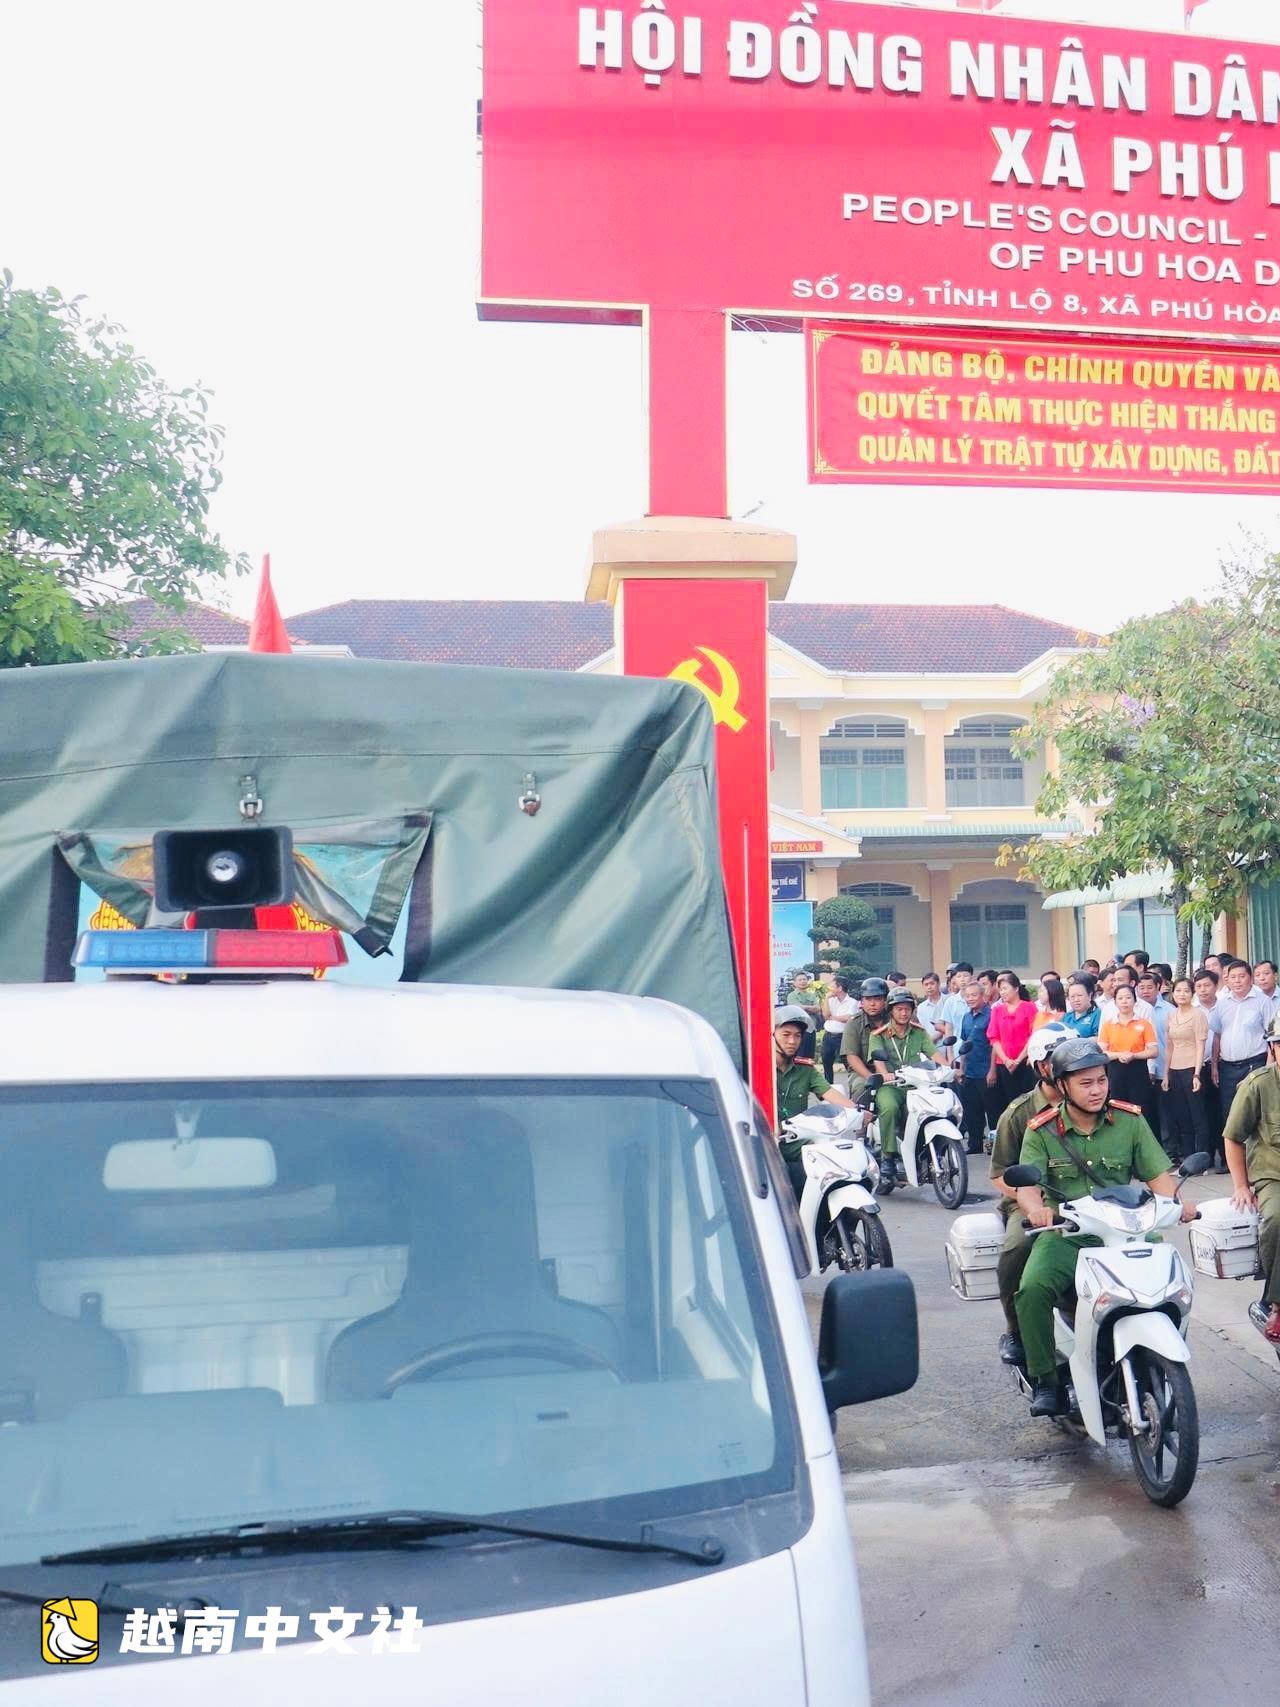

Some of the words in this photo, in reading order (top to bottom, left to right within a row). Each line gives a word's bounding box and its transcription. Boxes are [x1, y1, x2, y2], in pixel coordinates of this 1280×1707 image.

[578, 0, 701, 84] HỘI
[727, 2, 922, 92] ĐỒNG
[950, 37, 1146, 111] NHÂN
[991, 119, 1085, 187] XÃ
[1113, 132, 1243, 199] PHÚ
[989, 242, 1044, 269] OF
[1060, 247, 1143, 276] PHU
[1158, 253, 1242, 282] HOA
[793, 274, 839, 299] SỐ
[849, 283, 914, 305] 269,
[922, 280, 997, 307] TỈNH
[1010, 288, 1052, 314] LỘ
[1064, 295, 1087, 314] 8,
[1100, 294, 1140, 315] XÃ
[1151, 298, 1213, 320] PHÚ
[861, 342, 953, 377] ĐẢNG
[962, 348, 1014, 384] BỘ,
[1025, 354, 1124, 384] CHÍNH
[1133, 352, 1235, 390] QUYỀN
[1244, 365, 1280, 392] VÀ
[857, 387, 950, 420] QUYẾT
[957, 393, 1022, 423] TÂM
[1030, 399, 1104, 431] THỰC
[1110, 399, 1178, 431] HIỆN
[1184, 398, 1277, 433] THẮNG
[859, 429, 936, 463] QUẢN
[942, 436, 972, 463] LÝ
[981, 436, 1044, 467] TRẬT
[1053, 441, 1087, 470] TỰ
[1091, 440, 1141, 469] XÂY
[1149, 445, 1227, 474] DỰNG,
[1234, 444, 1280, 473] ĐẤT
